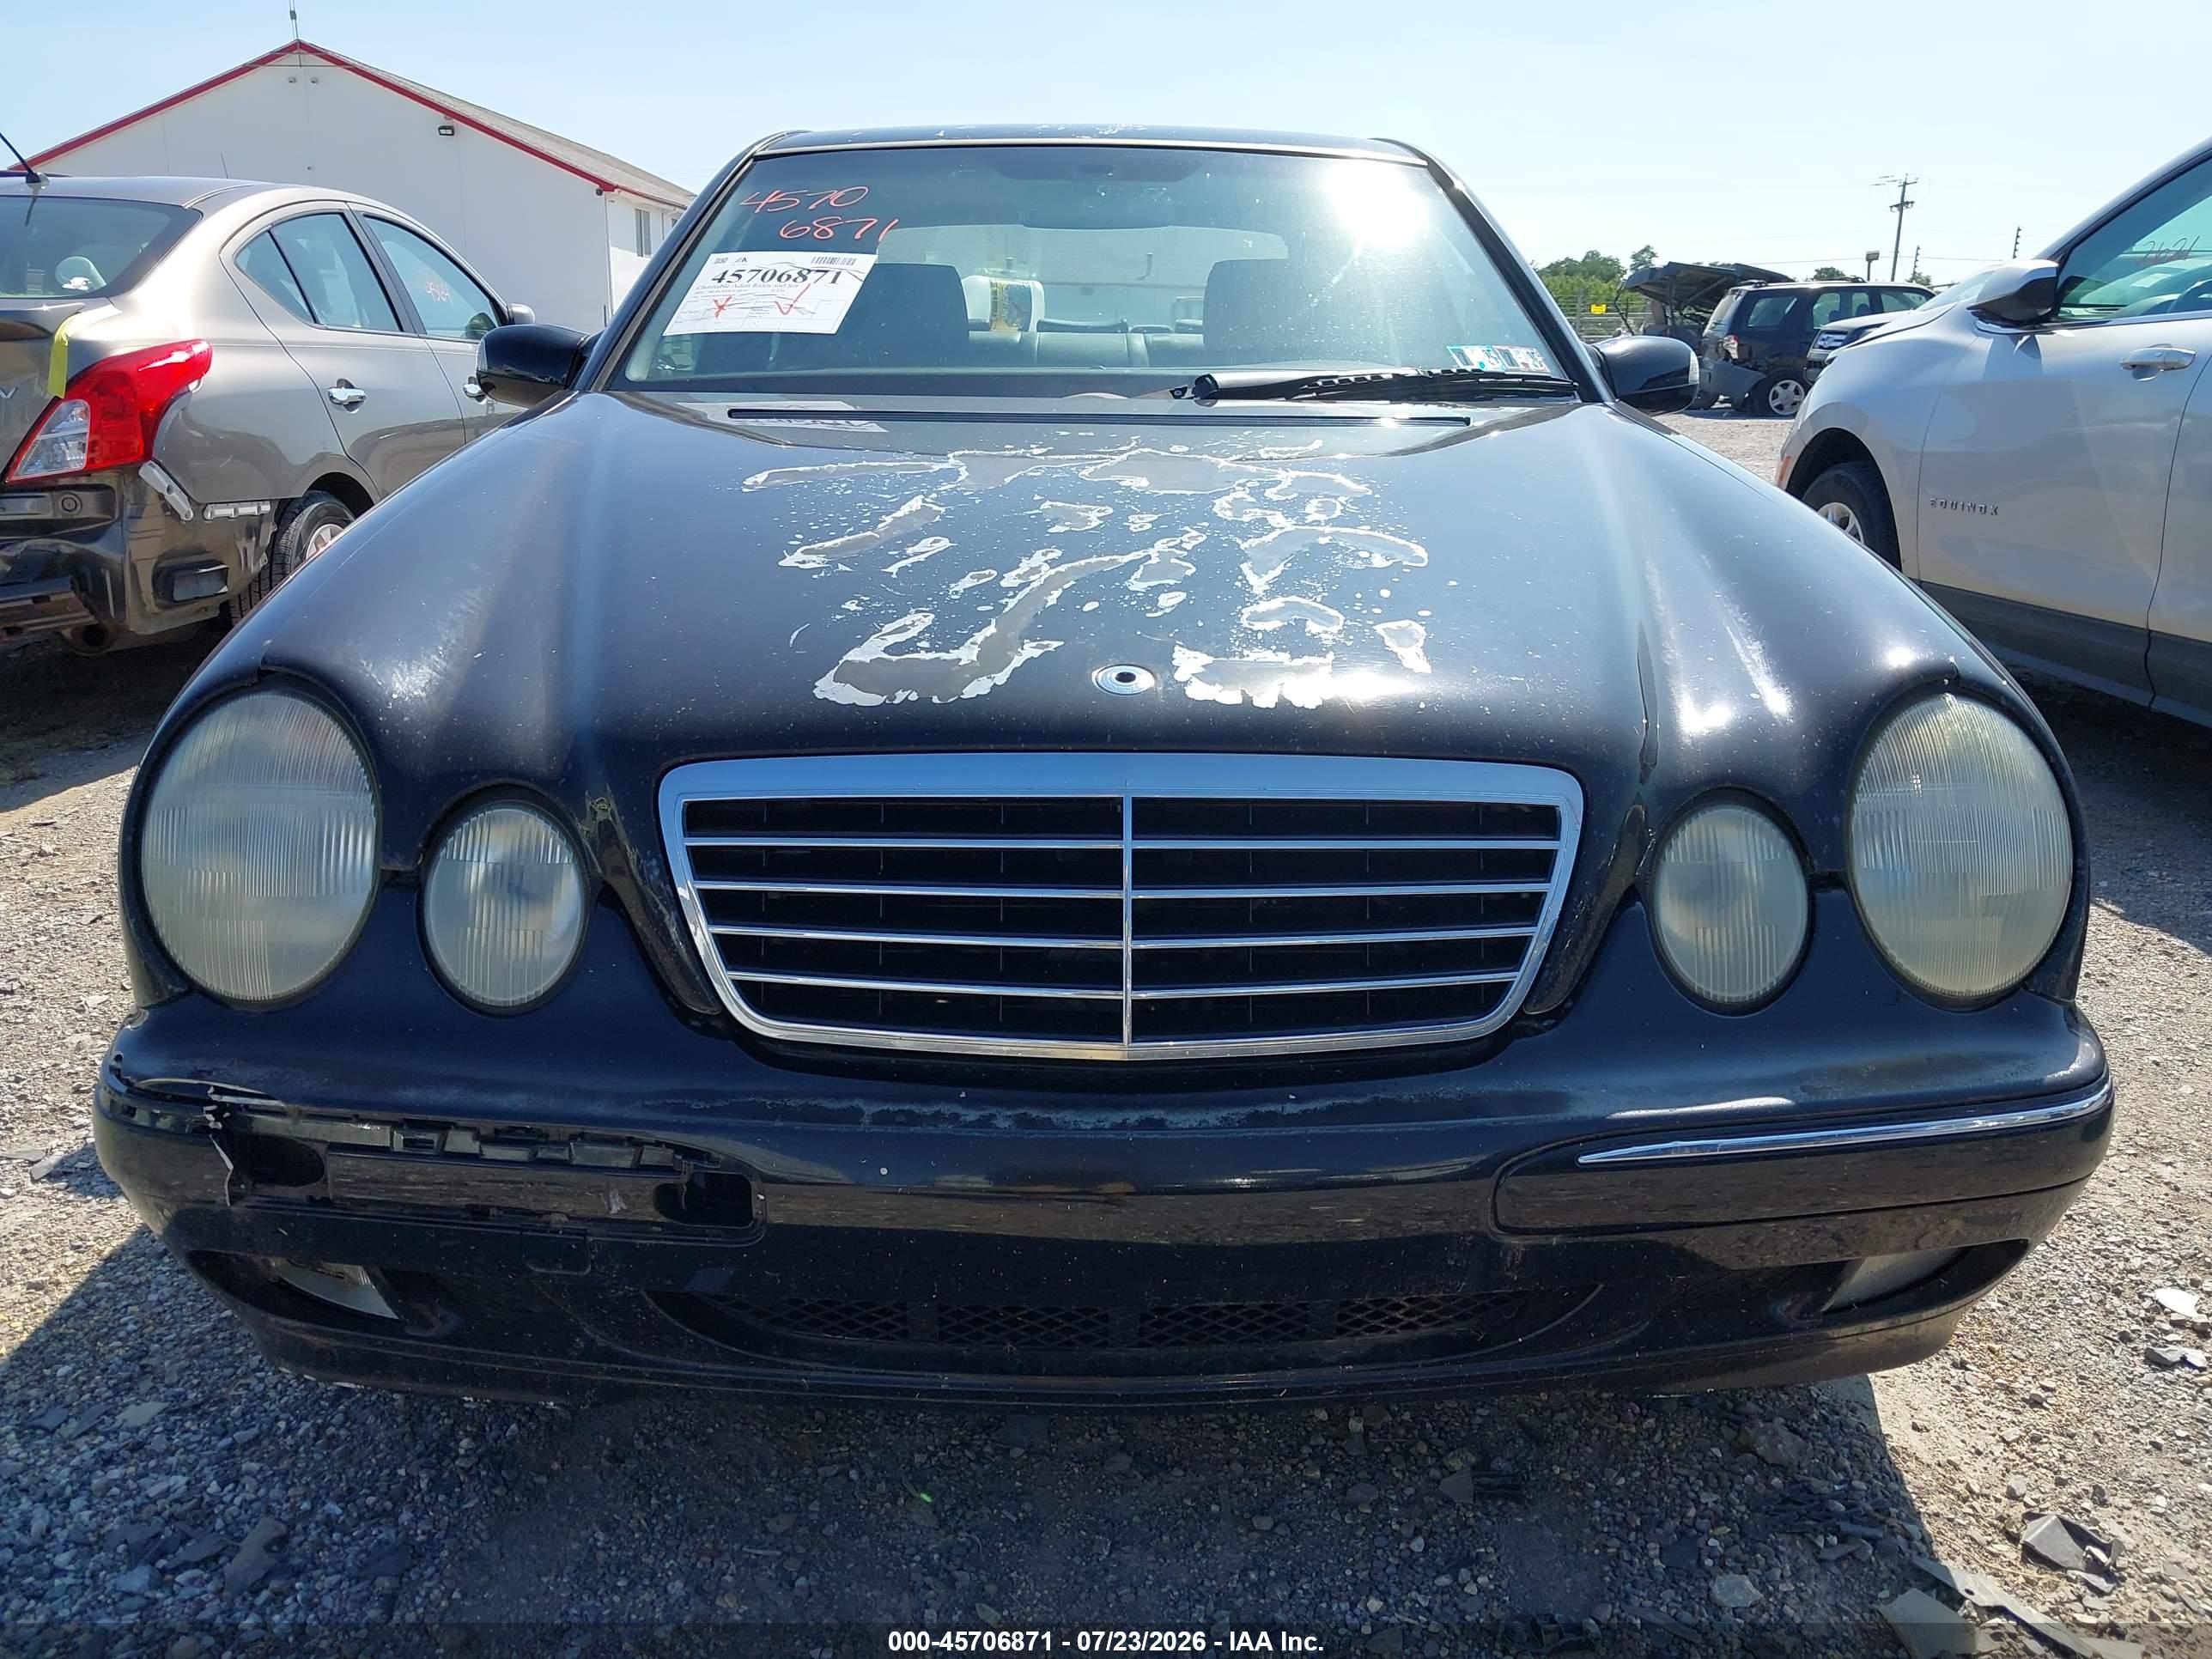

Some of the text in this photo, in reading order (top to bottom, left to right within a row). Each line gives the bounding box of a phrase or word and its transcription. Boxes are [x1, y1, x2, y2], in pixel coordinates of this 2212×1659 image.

[740, 185, 870, 214] 4570
[779, 216, 900, 242] 6871
[711, 268, 842, 285] 45706871
[1929, 498, 1999, 516] EQUINOX
